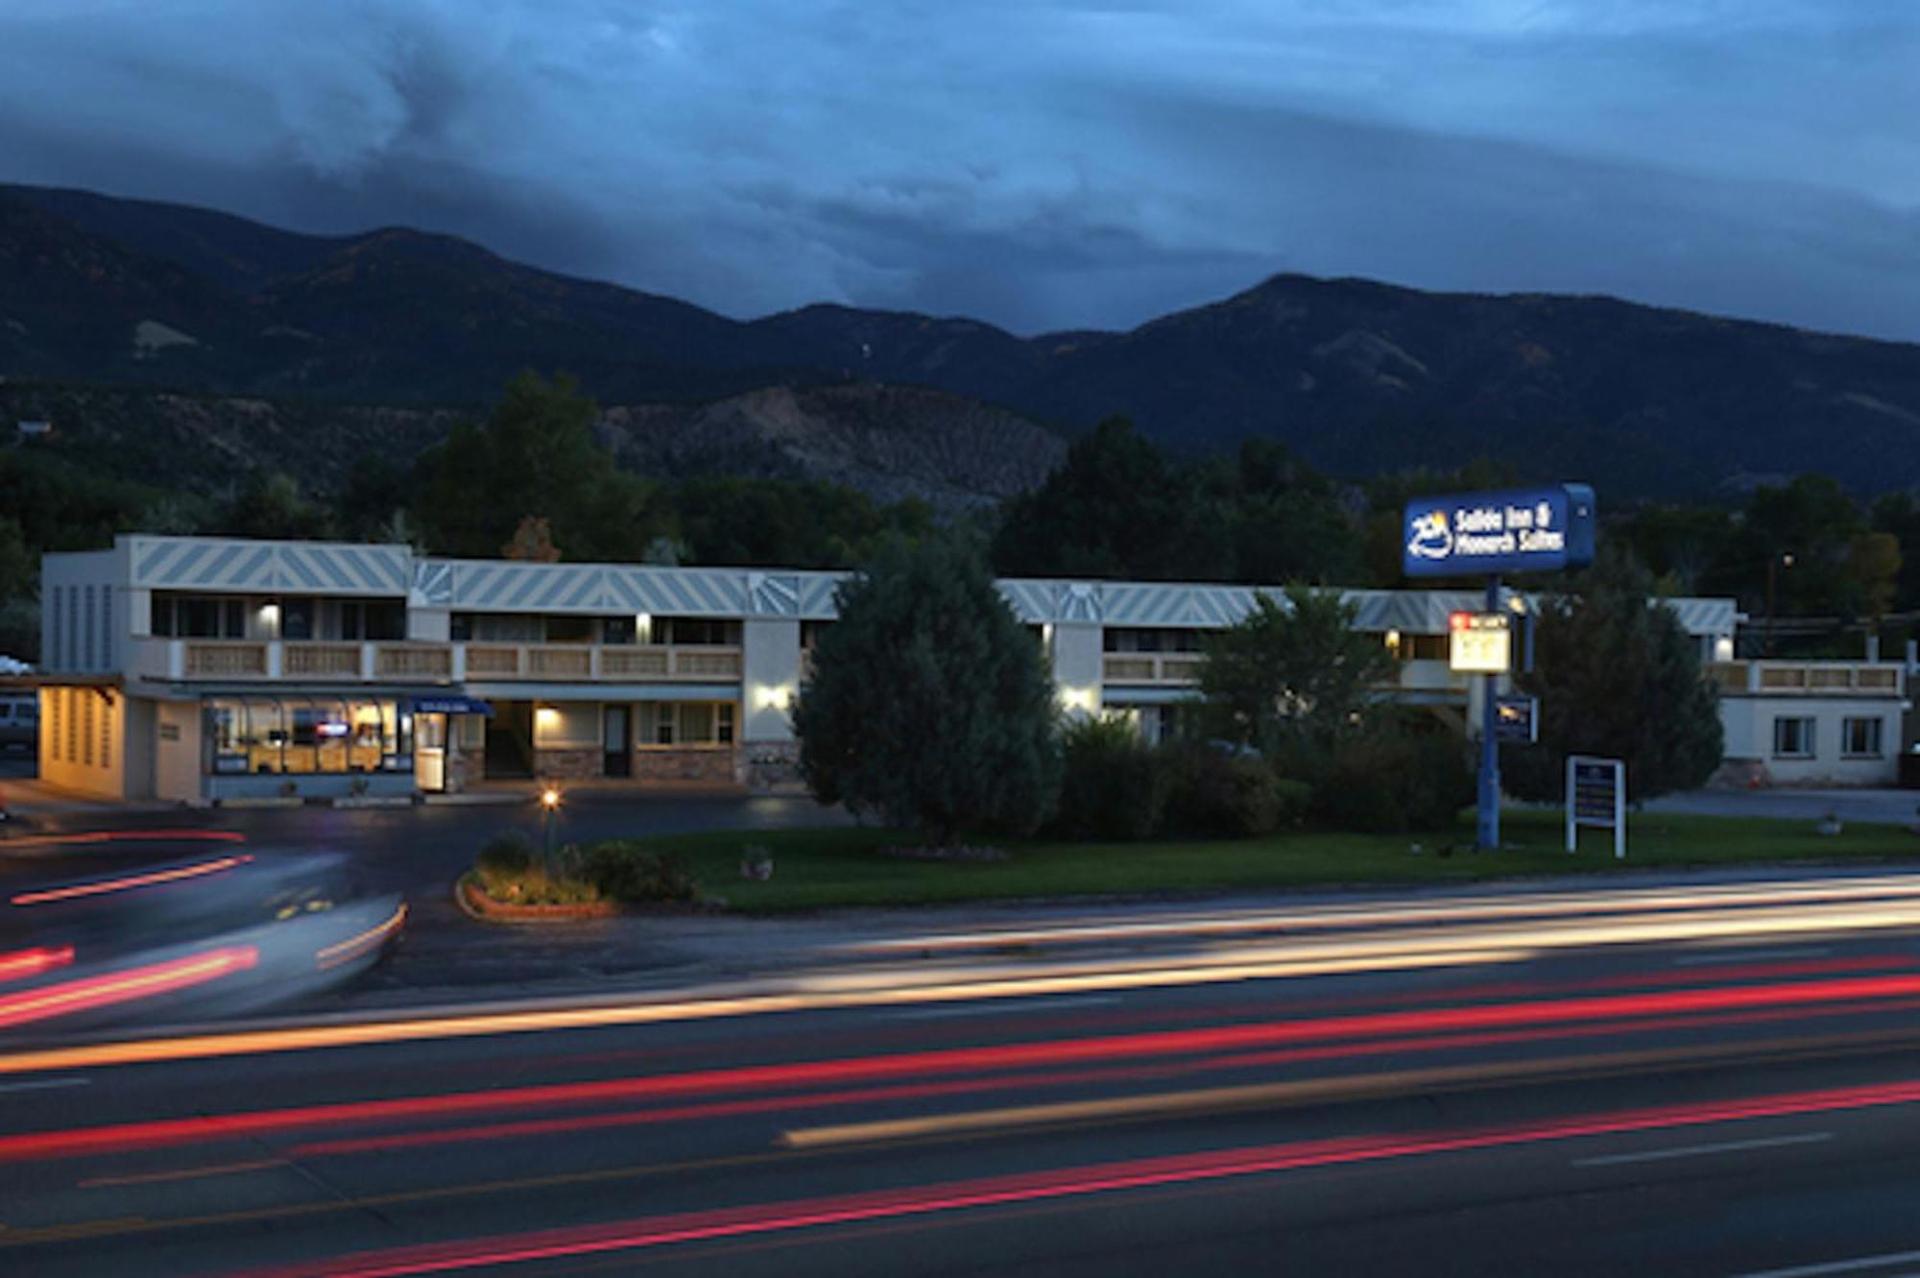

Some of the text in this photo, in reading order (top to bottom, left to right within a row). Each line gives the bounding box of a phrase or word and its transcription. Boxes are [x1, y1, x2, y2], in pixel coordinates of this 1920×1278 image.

[1505, 506, 1533, 529] Inn
[1535, 501, 1552, 527] &
[1519, 529, 1564, 551] Suites
